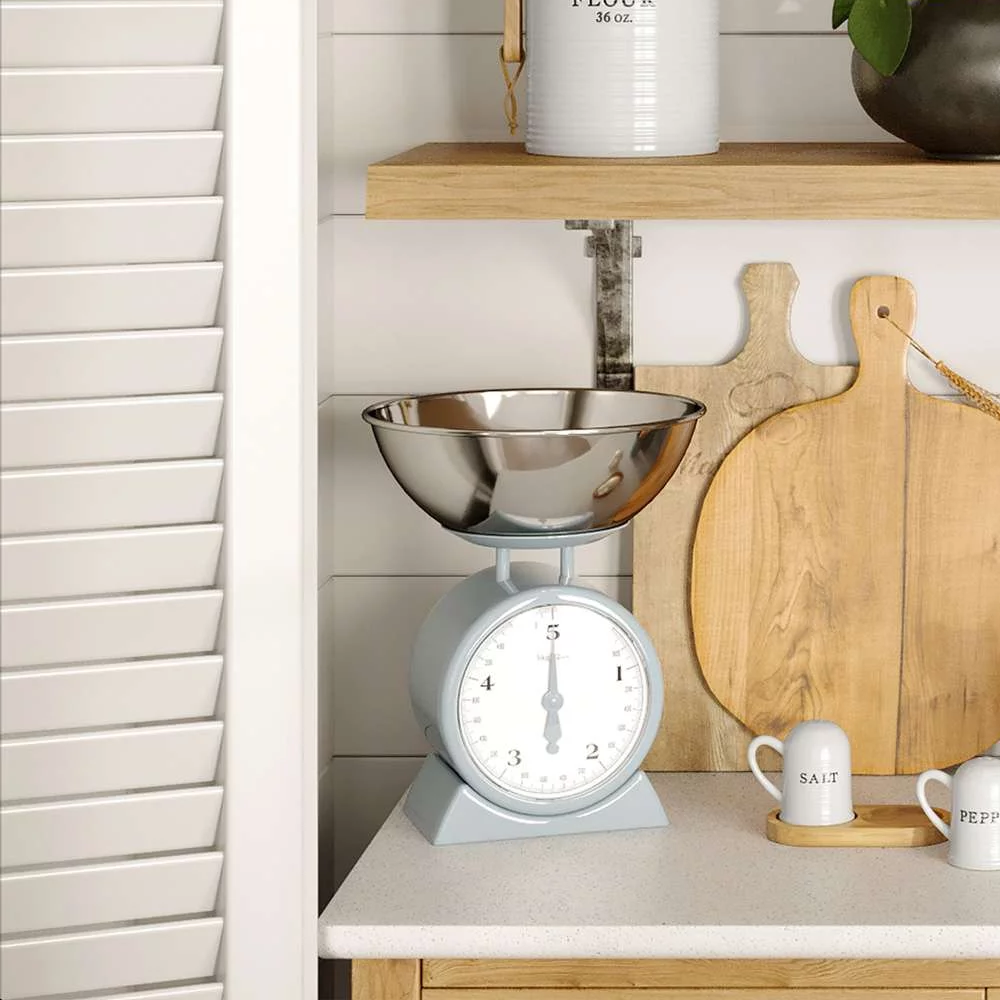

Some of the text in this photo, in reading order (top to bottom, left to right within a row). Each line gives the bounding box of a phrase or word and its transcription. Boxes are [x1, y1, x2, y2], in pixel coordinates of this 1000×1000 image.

[595, 11, 634, 23] 36 oz.
[546, 623, 561, 641] 5
[615, 665, 623, 682] 1
[480, 674, 495, 691] 4
[507, 749, 522, 767] 3
[586, 743, 599, 760] 2
[799, 771, 839, 784] SALT
